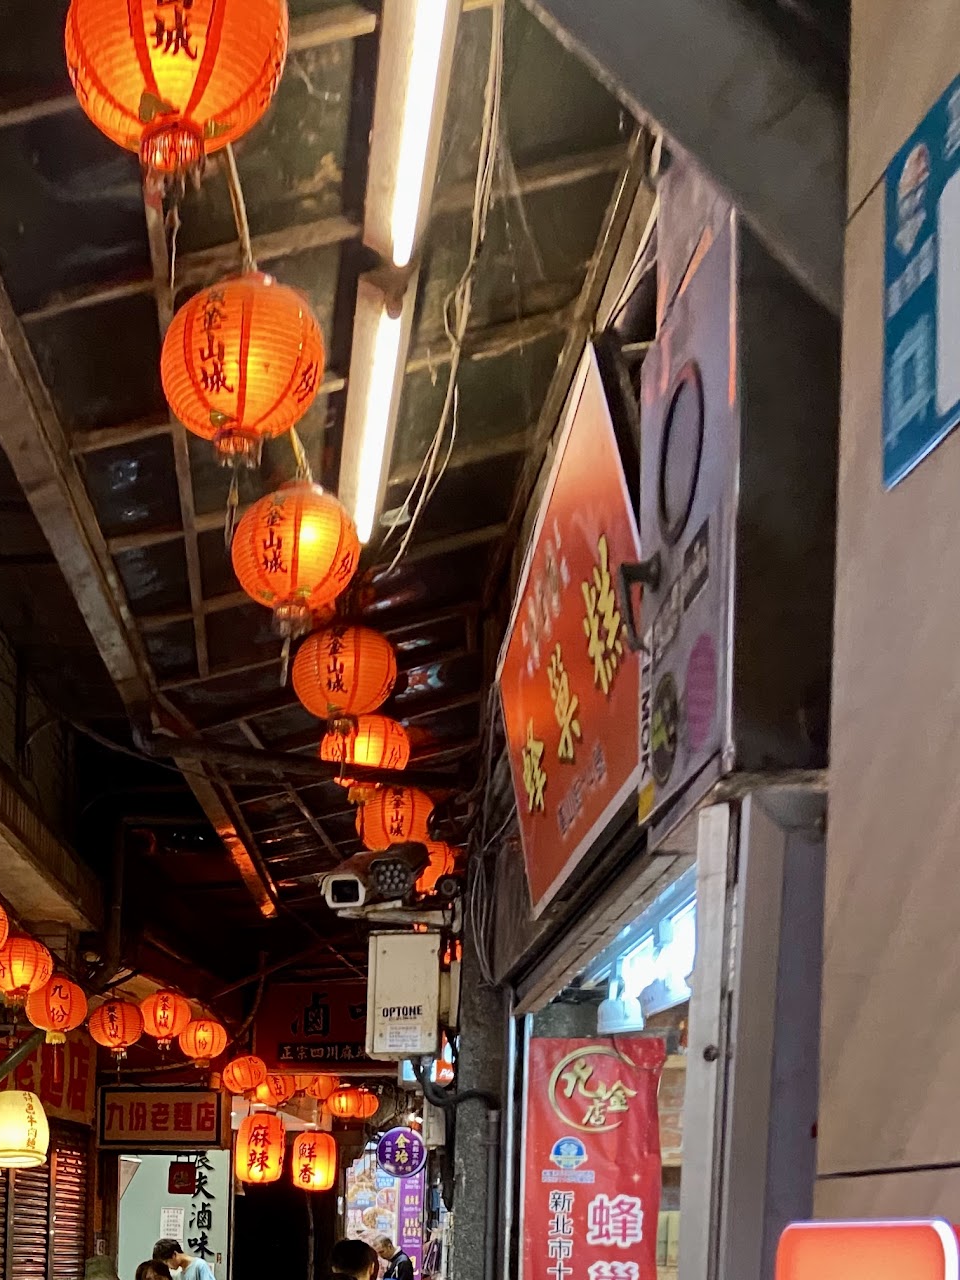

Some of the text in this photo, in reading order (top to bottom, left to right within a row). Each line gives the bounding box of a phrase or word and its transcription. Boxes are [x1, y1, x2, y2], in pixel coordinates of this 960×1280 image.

[50, 984, 69, 1023] 九份
[290, 991, 367, 1039] 滷
[247, 1124, 272, 1172] 麻辣
[298, 1142, 317, 1183] 鮮香
